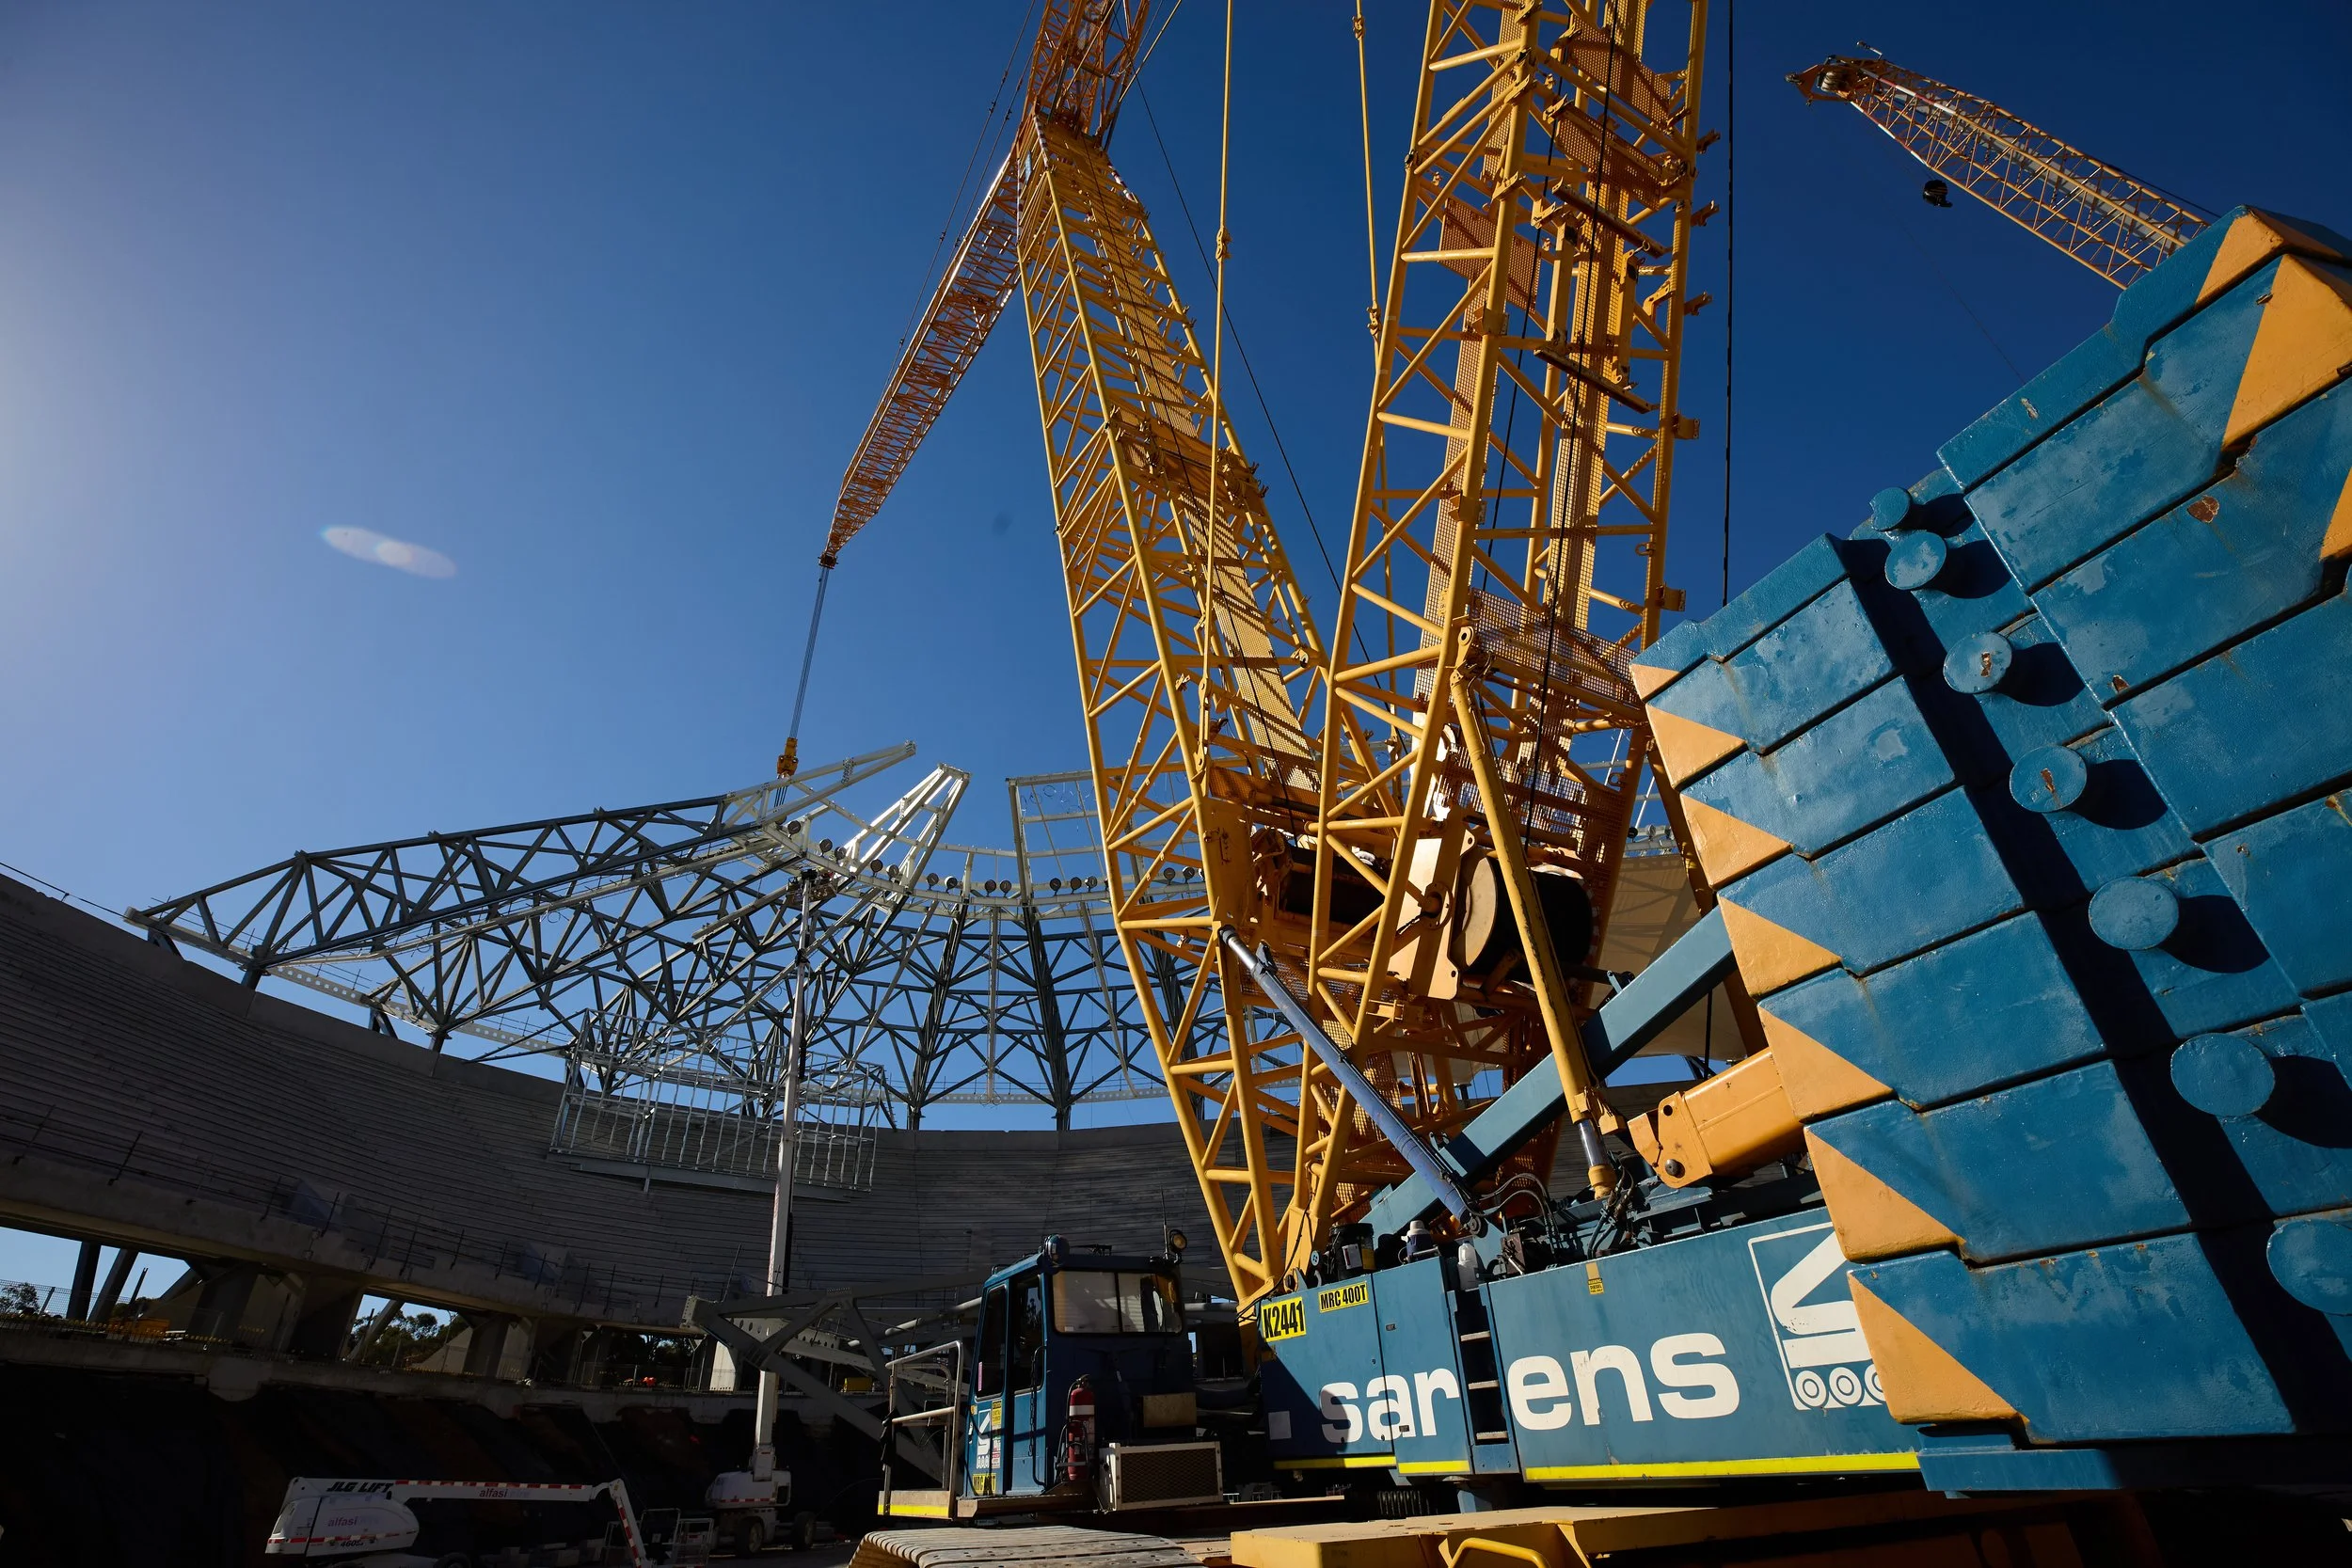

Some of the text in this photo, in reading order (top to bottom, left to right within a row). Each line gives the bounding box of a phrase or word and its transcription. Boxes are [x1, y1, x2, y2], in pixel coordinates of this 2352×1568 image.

[1320, 1284, 1366, 1310] MRC 400T
[1263, 1300, 1305, 1339] K2441
[326, 1481, 394, 1493] JLG LIFT
[479, 1487, 509, 1498] alfasi
[328, 1515, 358, 1528] alfasi
